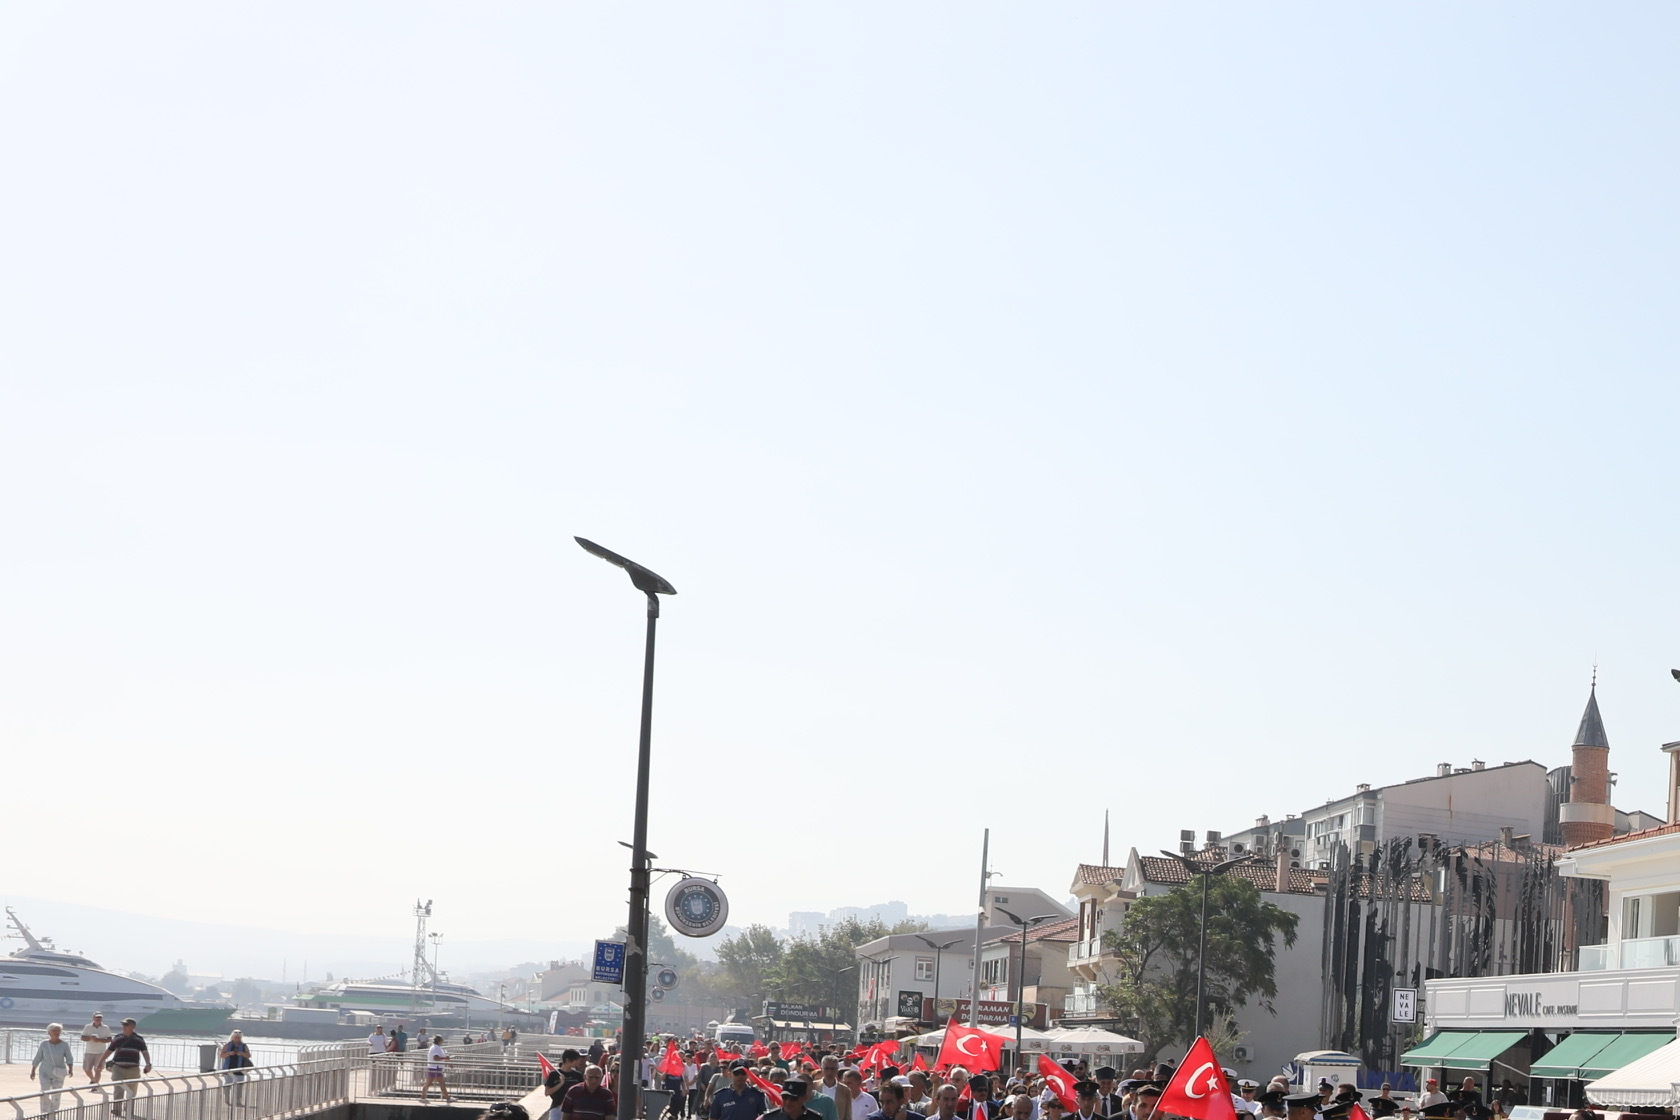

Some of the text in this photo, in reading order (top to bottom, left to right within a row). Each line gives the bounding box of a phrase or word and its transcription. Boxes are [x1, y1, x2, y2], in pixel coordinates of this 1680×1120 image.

[595, 966, 620, 974] BURSA
[960, 1003, 1010, 1013] KARAMAN
[1504, 992, 1542, 1018] NEVALE
[961, 1013, 1008, 1023] DODURMA
